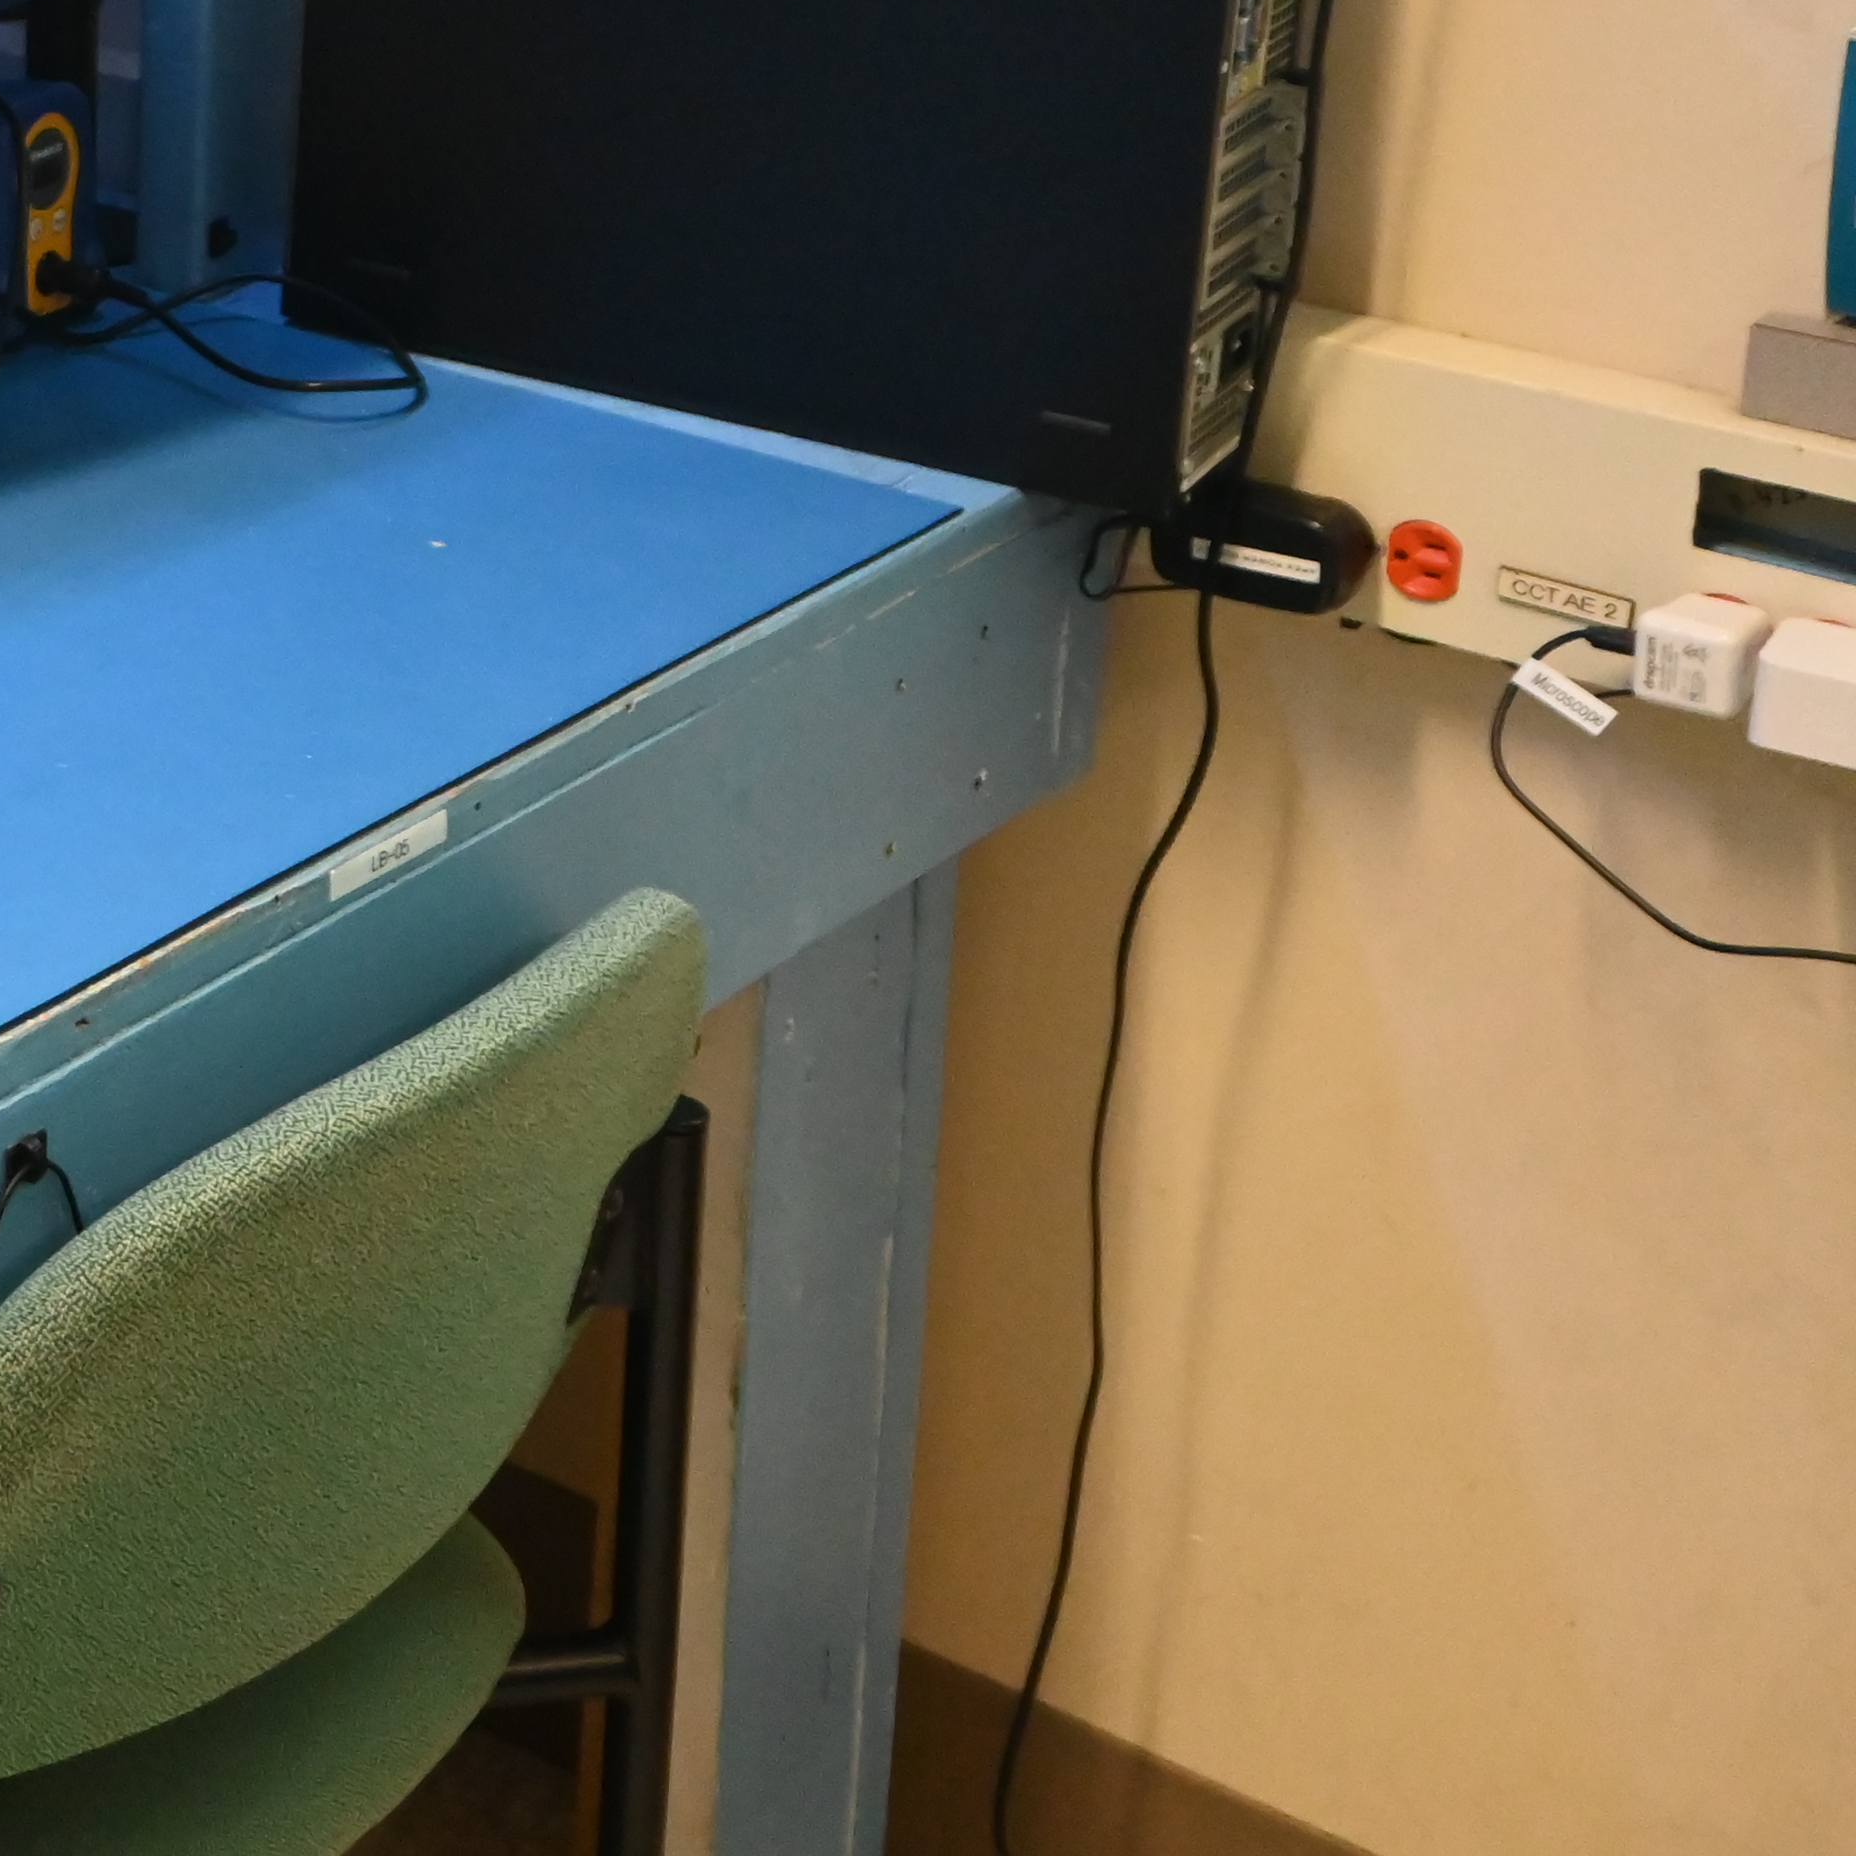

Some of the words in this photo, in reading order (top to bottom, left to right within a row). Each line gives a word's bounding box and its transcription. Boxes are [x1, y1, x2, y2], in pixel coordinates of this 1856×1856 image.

[1512, 579, 1560, 604] CCT
[1563, 593, 1597, 615] AE
[1604, 603, 1618, 621] 2
[1531, 673, 1606, 728] Microscope
